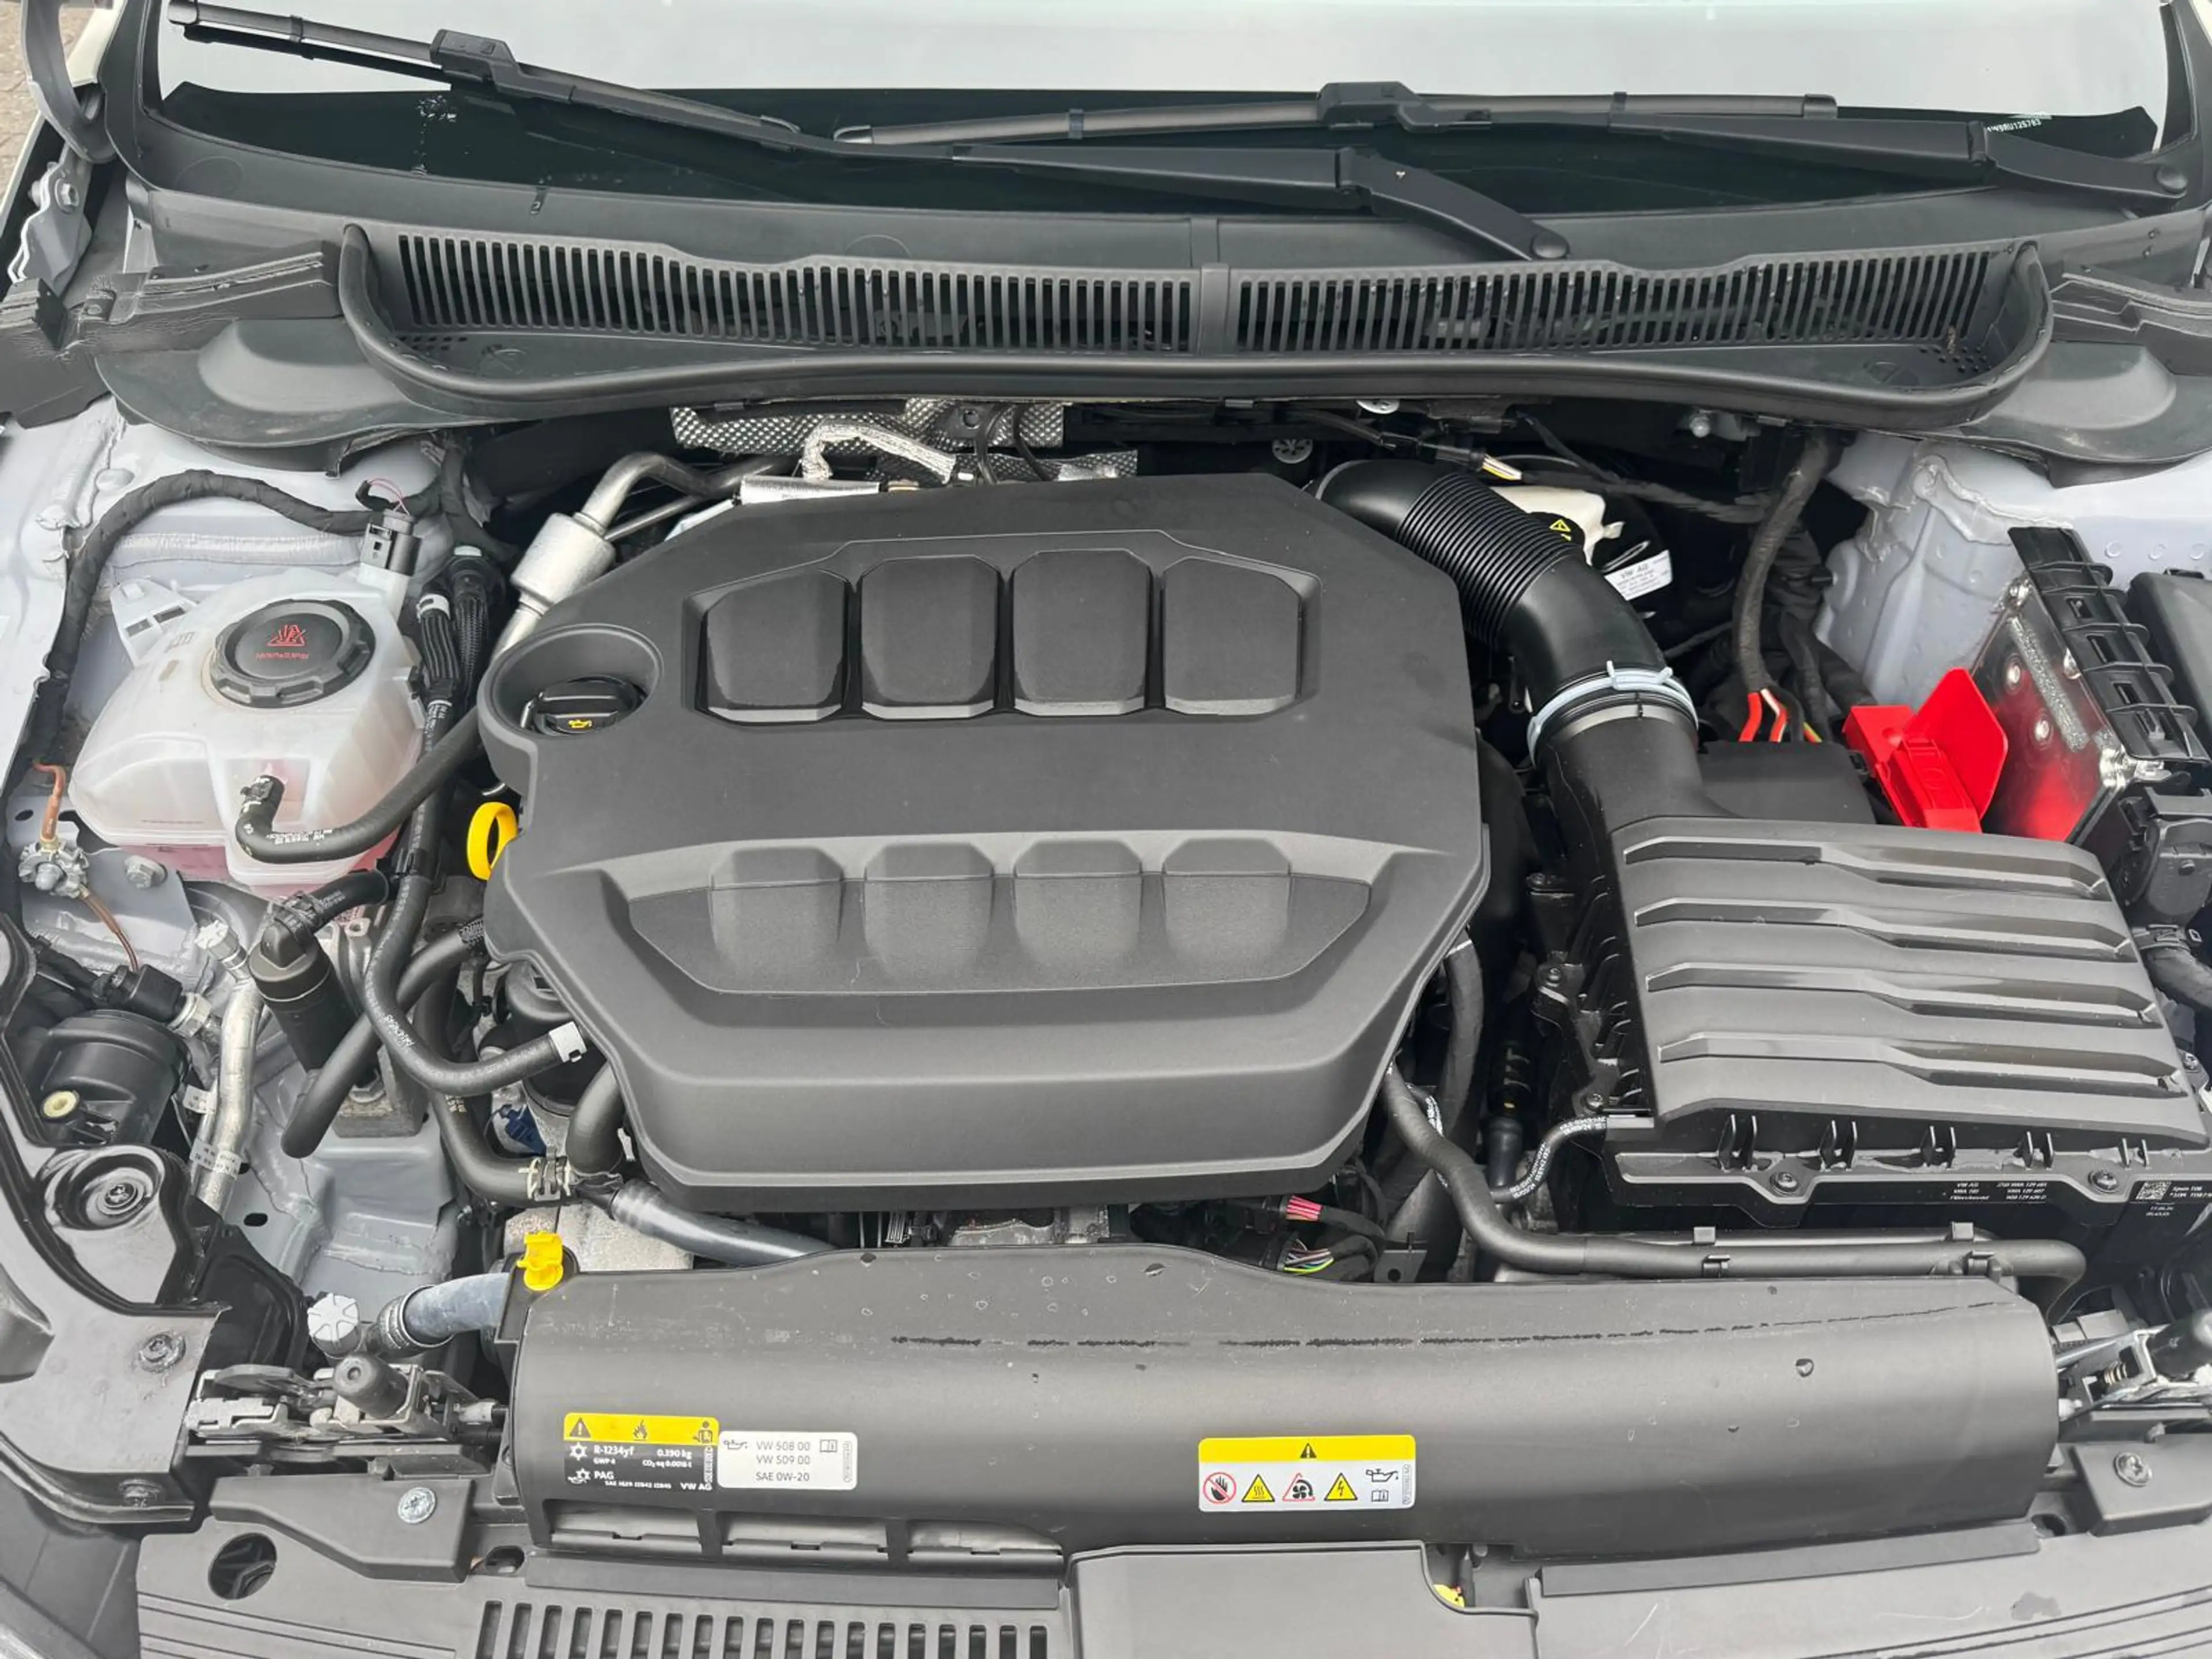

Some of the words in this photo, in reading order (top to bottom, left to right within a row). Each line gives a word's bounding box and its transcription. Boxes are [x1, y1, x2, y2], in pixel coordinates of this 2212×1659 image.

[756, 1441, 774, 1450] VW
[776, 1441, 794, 1451] 508
[797, 1441, 810, 1451] 00
[593, 1445, 634, 1458] R-1234yf
[756, 1455, 774, 1464] VW
[776, 1455, 795, 1465] 509
[797, 1455, 810, 1465] 00
[594, 1471, 615, 1479] PAG
[756, 1472, 774, 1482] SAE
[776, 1472, 810, 1482] 0W-20
[698, 1483, 713, 1491] AG
